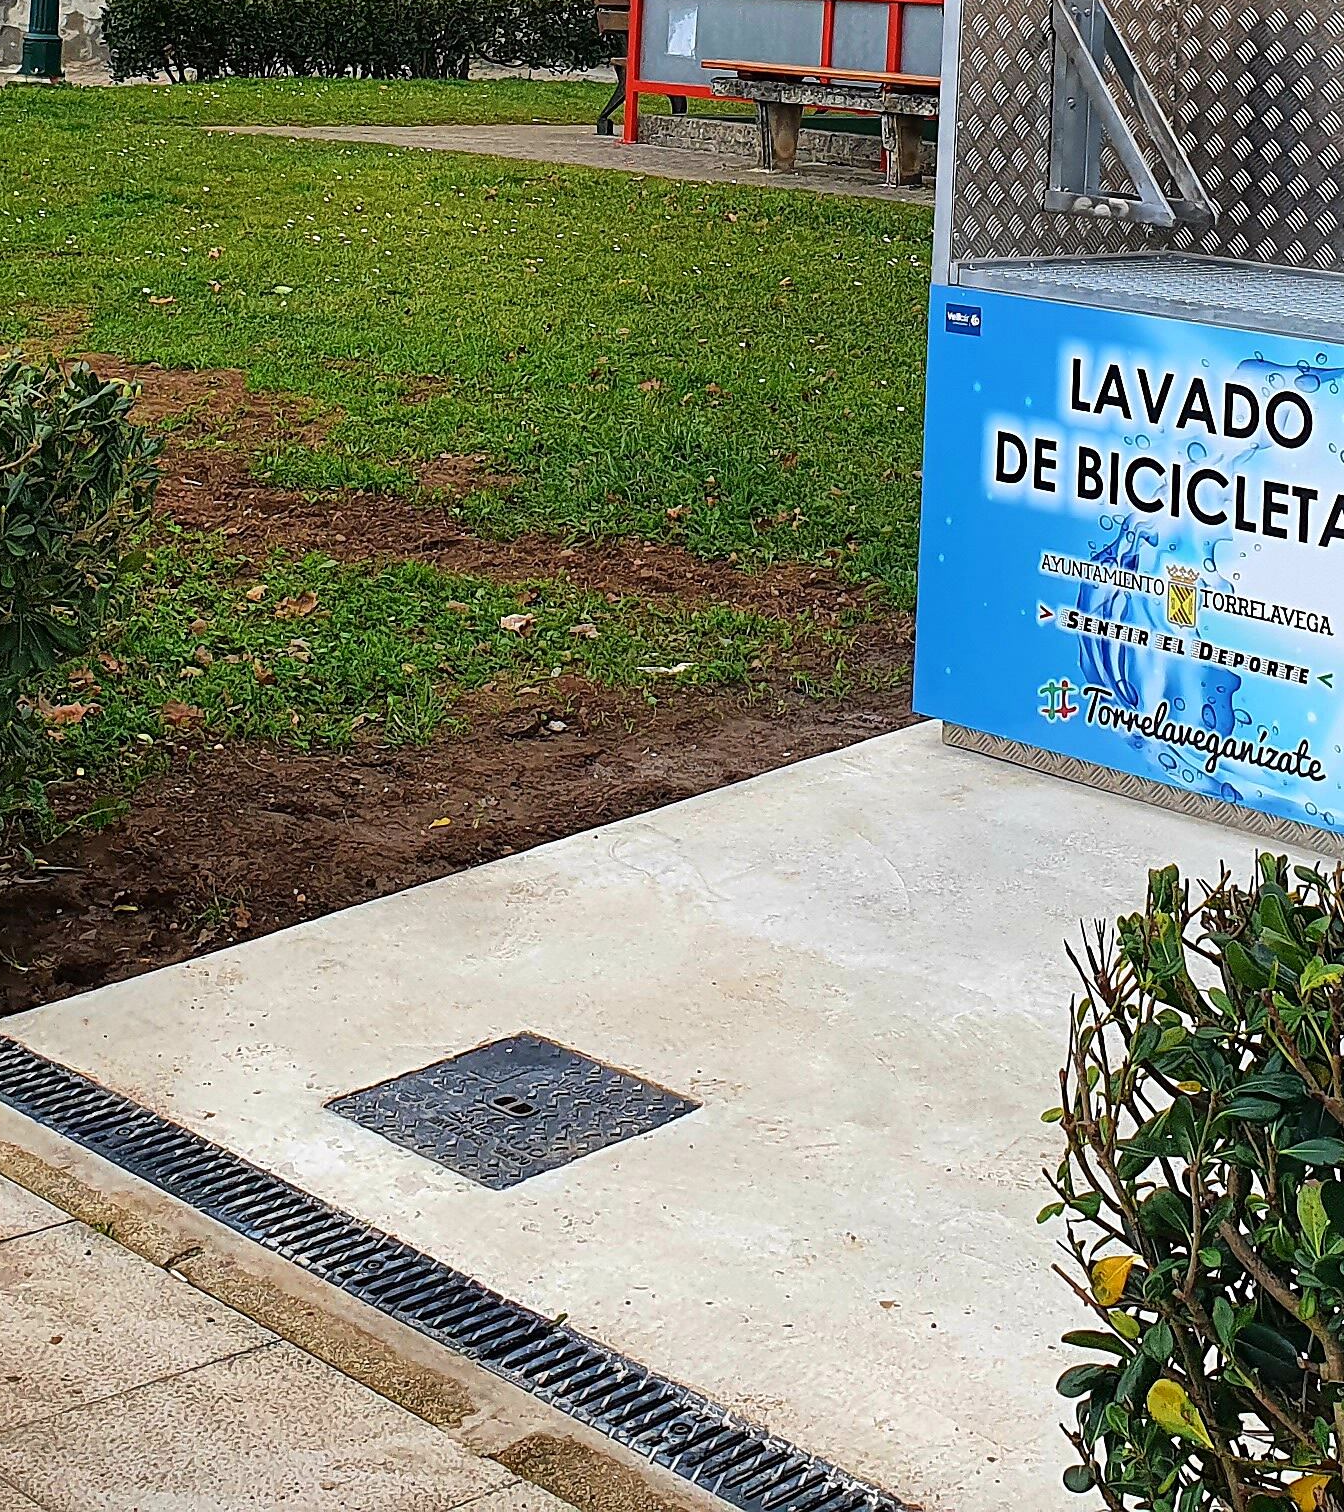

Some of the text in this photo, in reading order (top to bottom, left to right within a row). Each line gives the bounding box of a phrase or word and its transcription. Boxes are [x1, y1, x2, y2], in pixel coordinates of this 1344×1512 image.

[1070, 357, 1313, 449] LAVADO
[995, 431, 1058, 493] DE
[1042, 554, 1334, 636] AYUNTAMIENTO TORRELAVEGA
